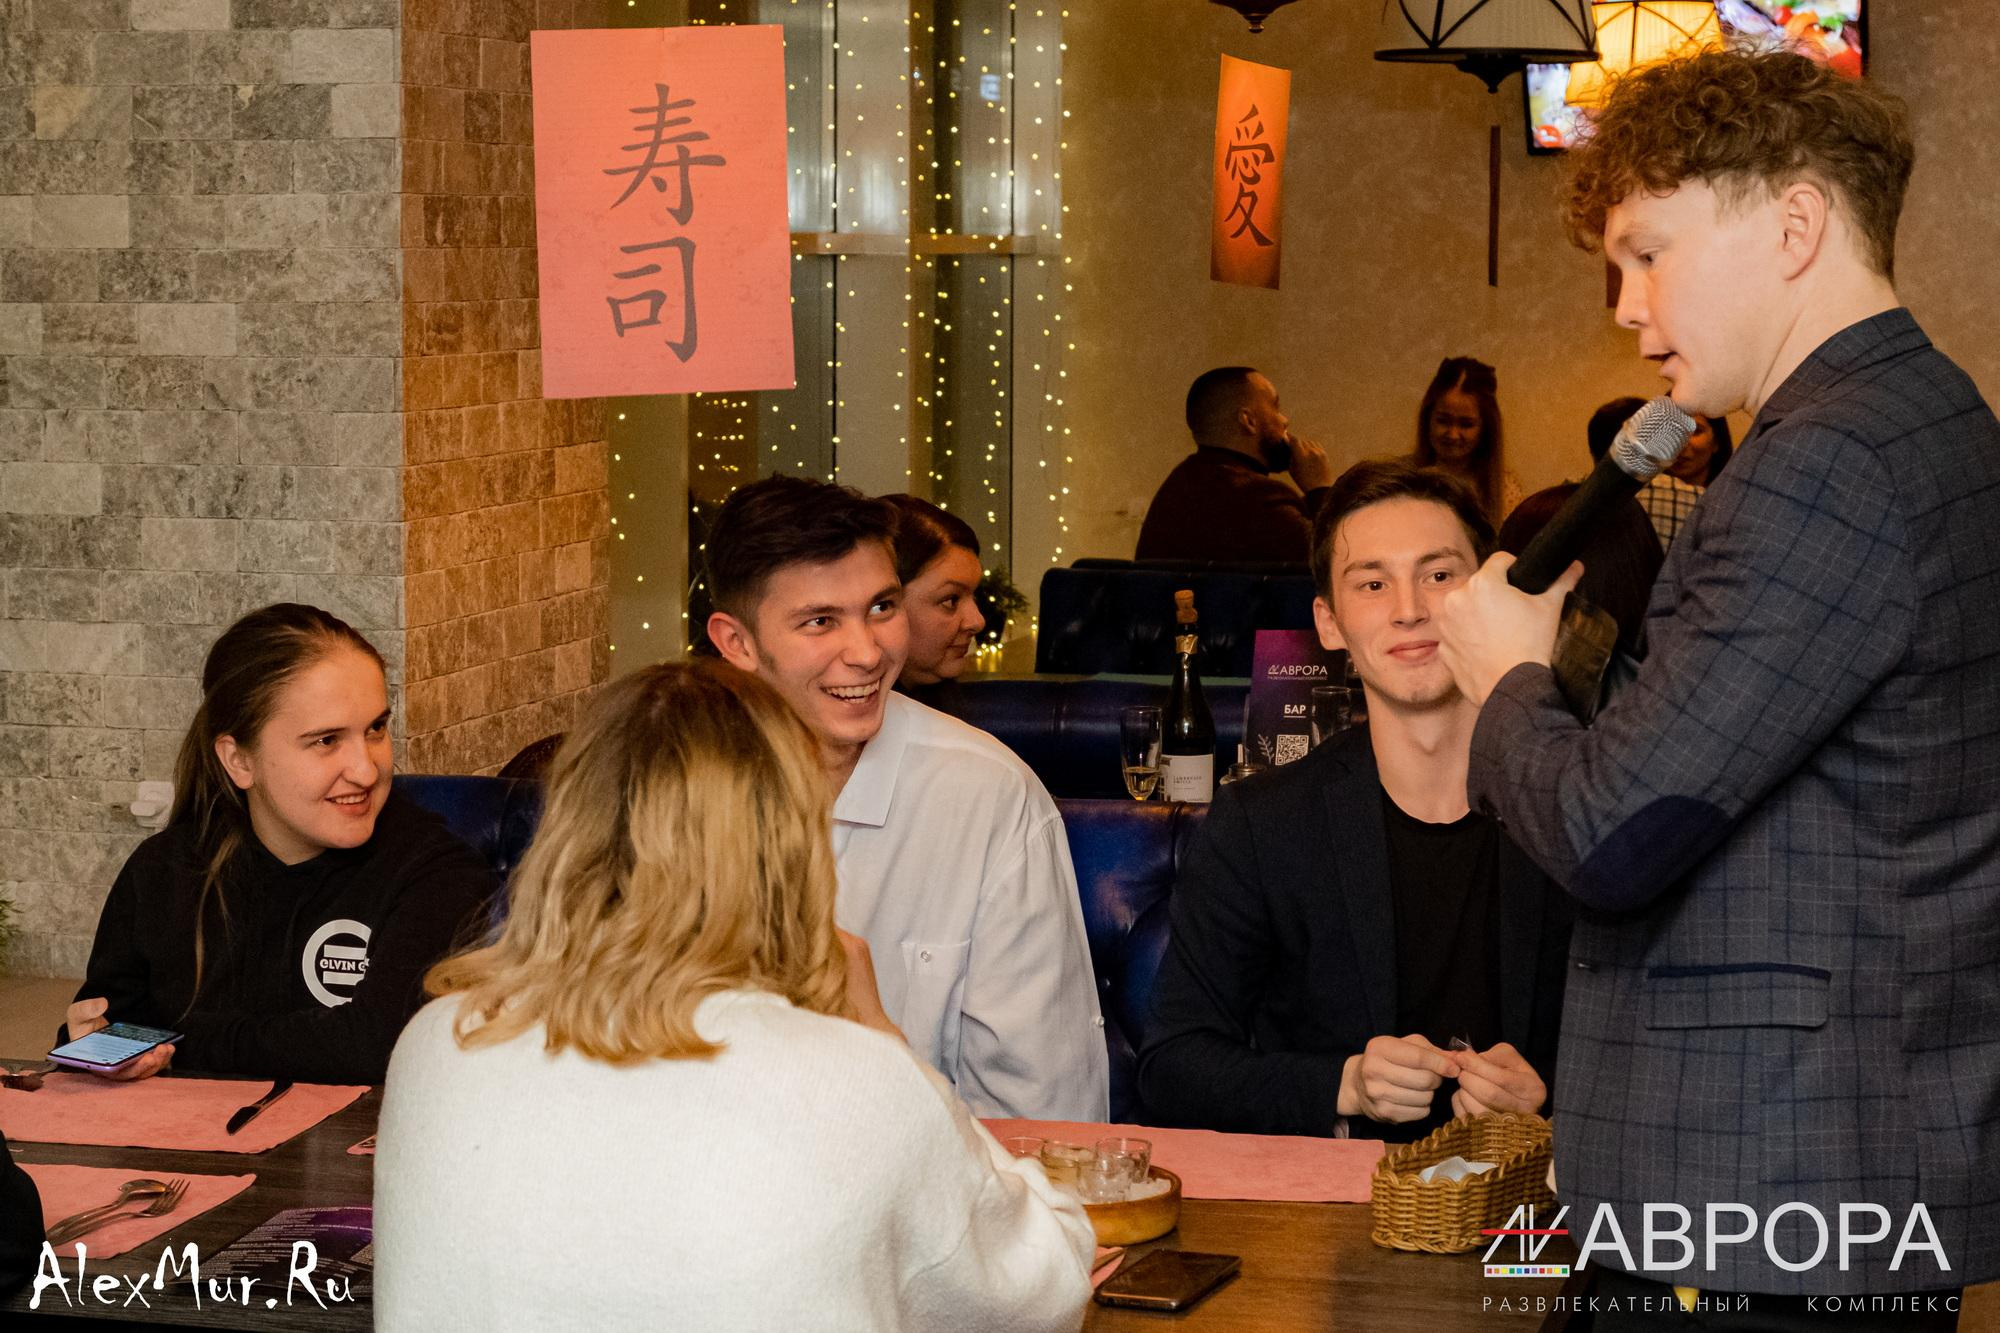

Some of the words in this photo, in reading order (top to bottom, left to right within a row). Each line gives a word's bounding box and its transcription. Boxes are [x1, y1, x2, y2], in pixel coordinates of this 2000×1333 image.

[1223, 103, 1276, 247] 愛
[602, 82, 727, 364] 寿司
[1279, 665, 1328, 676] АВРОРА
[1284, 704, 1307, 715] БАР
